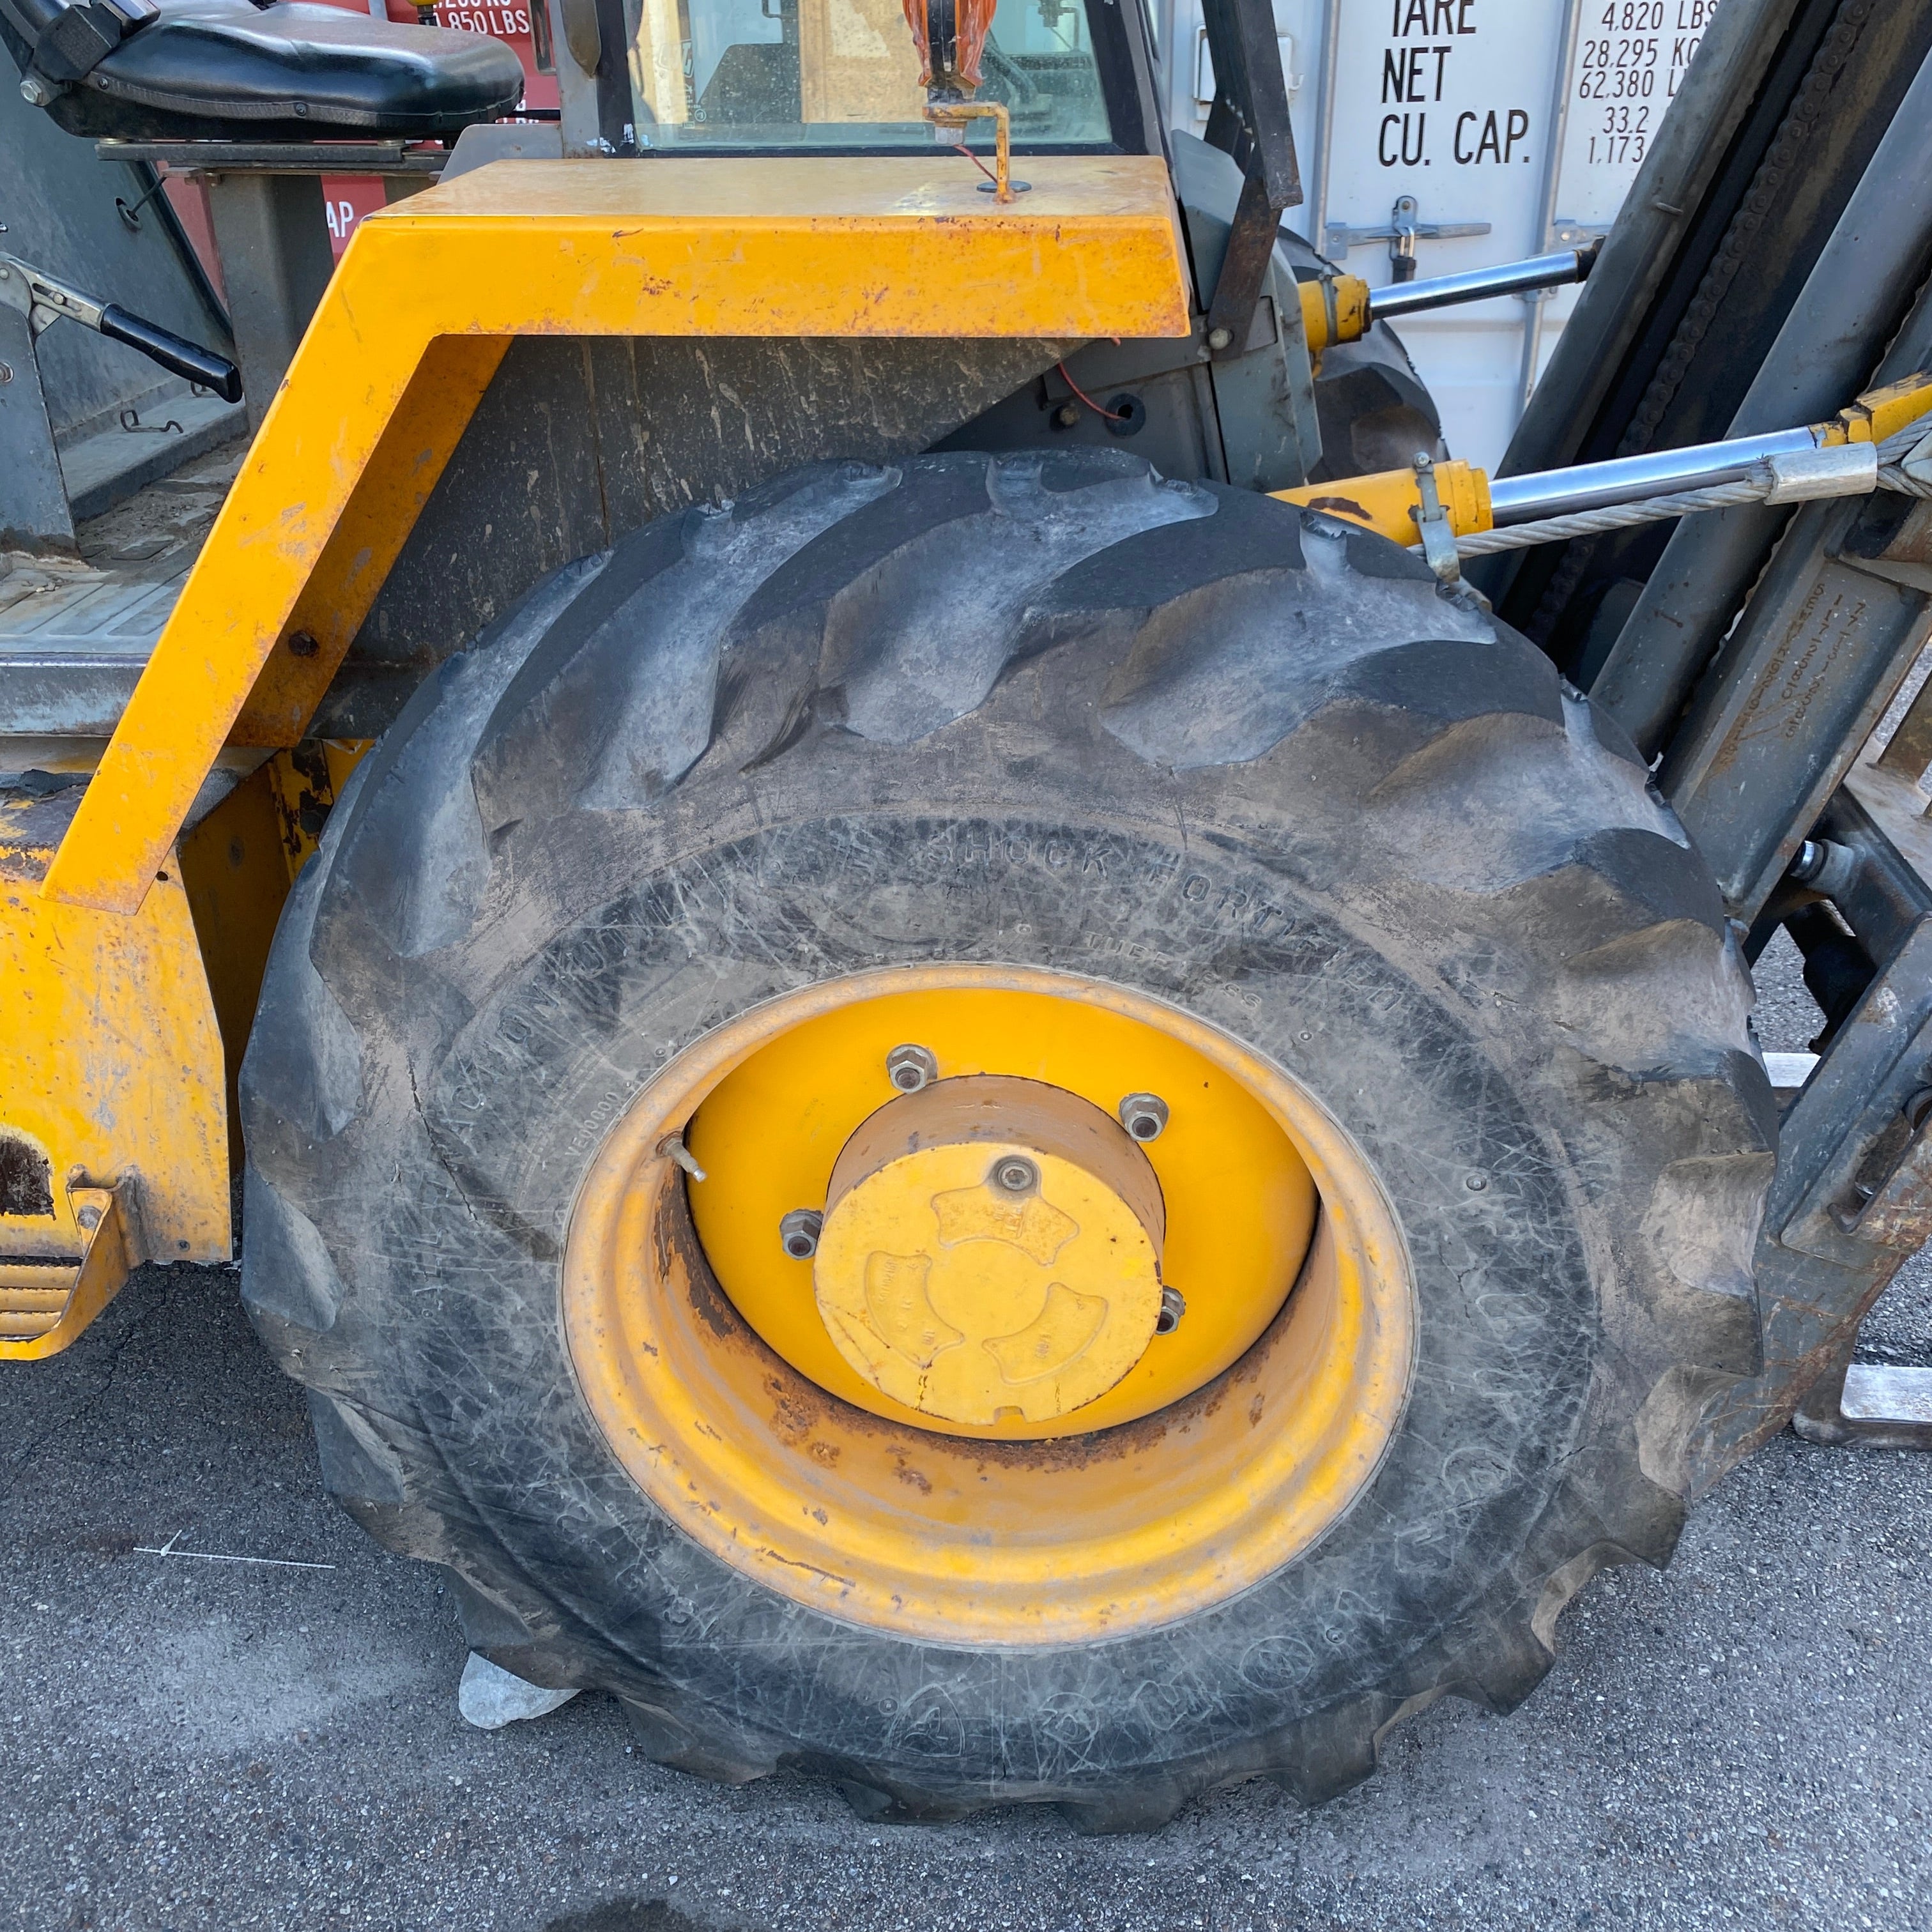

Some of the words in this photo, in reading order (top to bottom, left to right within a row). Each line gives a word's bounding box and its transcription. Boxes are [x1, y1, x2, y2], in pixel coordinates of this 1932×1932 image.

[489, 9, 530, 34] LBS
[1601, 1, 1664, 31] 4,820
[1582, 38, 1659, 68] 28,295
[1381, 45, 1452, 103] NET
[1579, 70, 1654, 99] 62,380
[1602, 105, 1650, 134] 33.2
[1379, 112, 1430, 167] CU.
[1454, 109, 1530, 165] CAP.
[1589, 136, 1645, 164] 1,173
[1081, 929, 1264, 1012] TUBELESS
